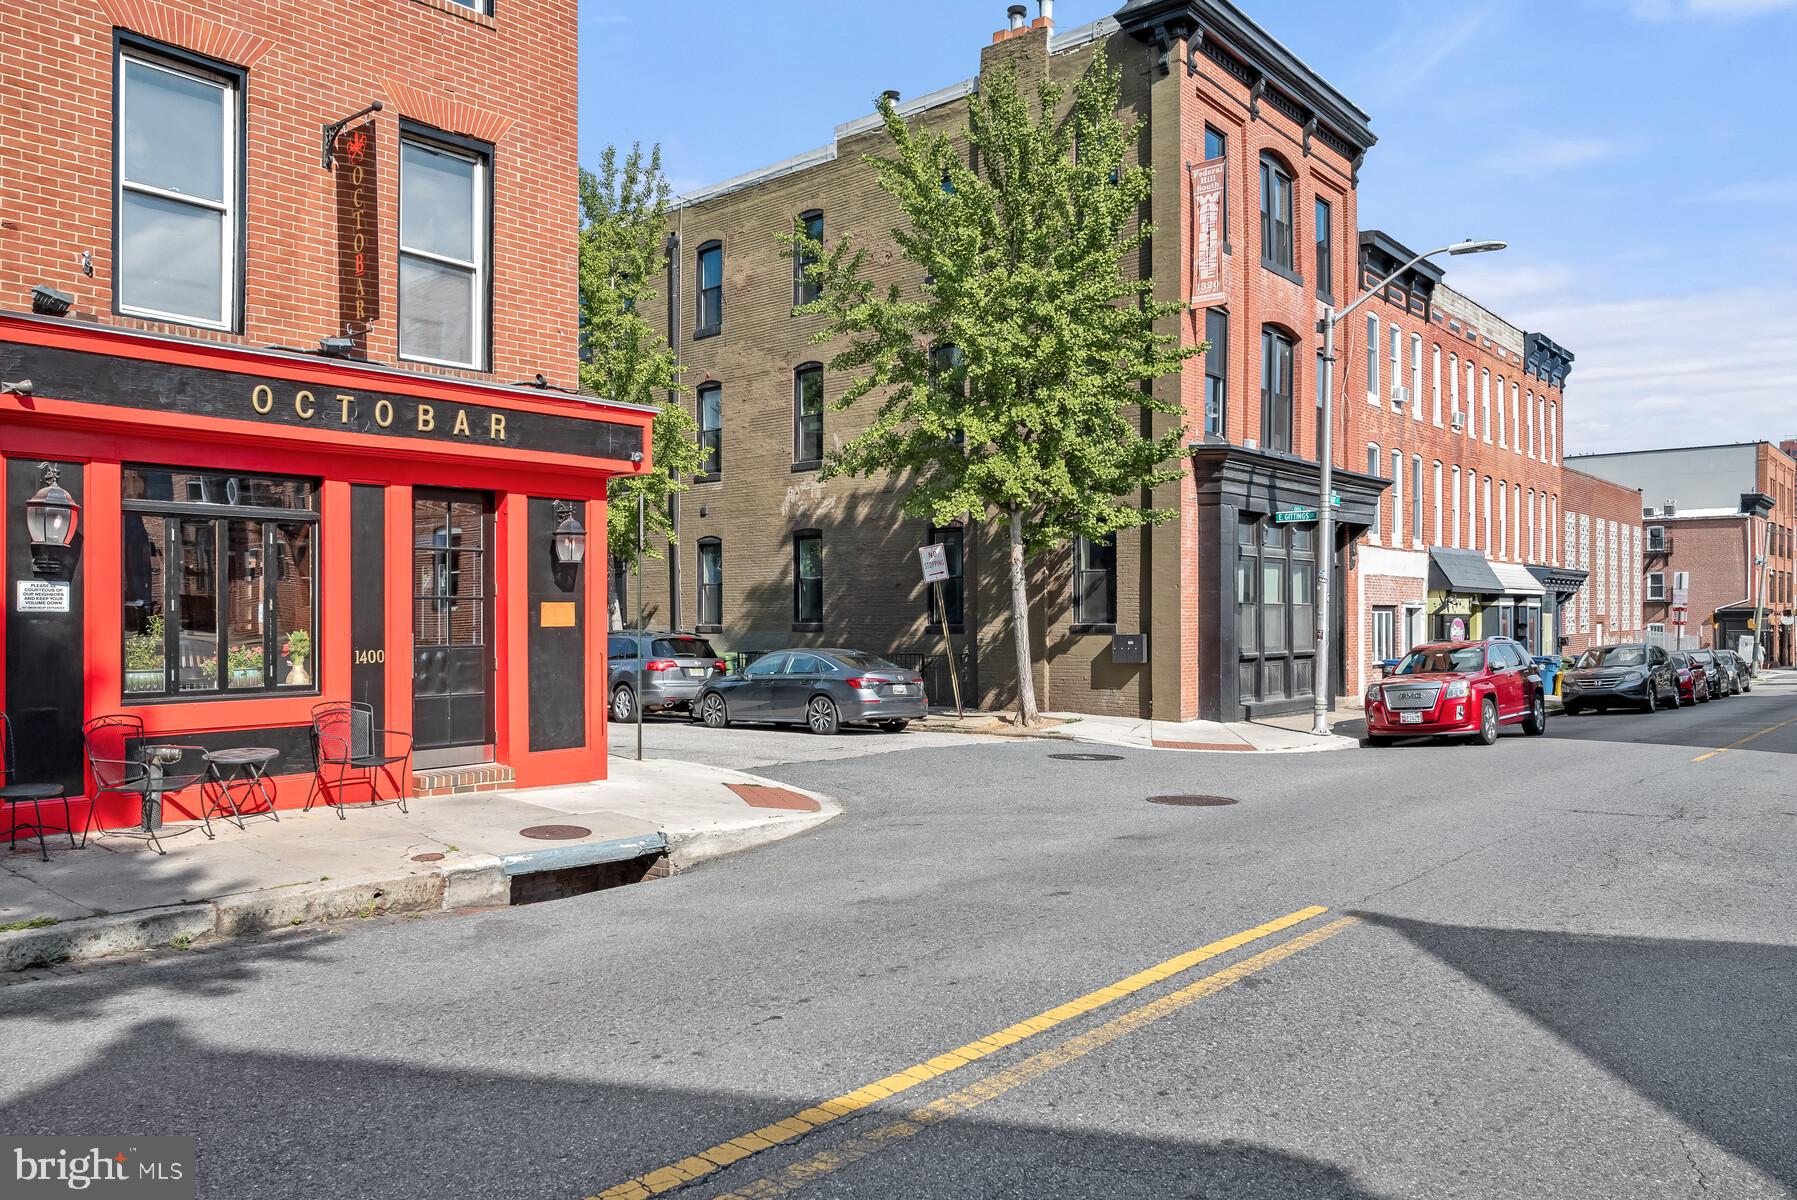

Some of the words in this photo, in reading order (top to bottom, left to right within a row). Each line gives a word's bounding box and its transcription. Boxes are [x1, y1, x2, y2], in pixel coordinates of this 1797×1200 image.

[1194, 166, 1223, 178] Federal
[1200, 175, 1216, 184] Hill
[1196, 182, 1219, 192] South
[352, 166, 365, 319] OCTOBAR
[252, 385, 506, 441] OCTOBAR
[1284, 512, 1309, 520] GITTINGS
[354, 649, 385, 664] 1400
